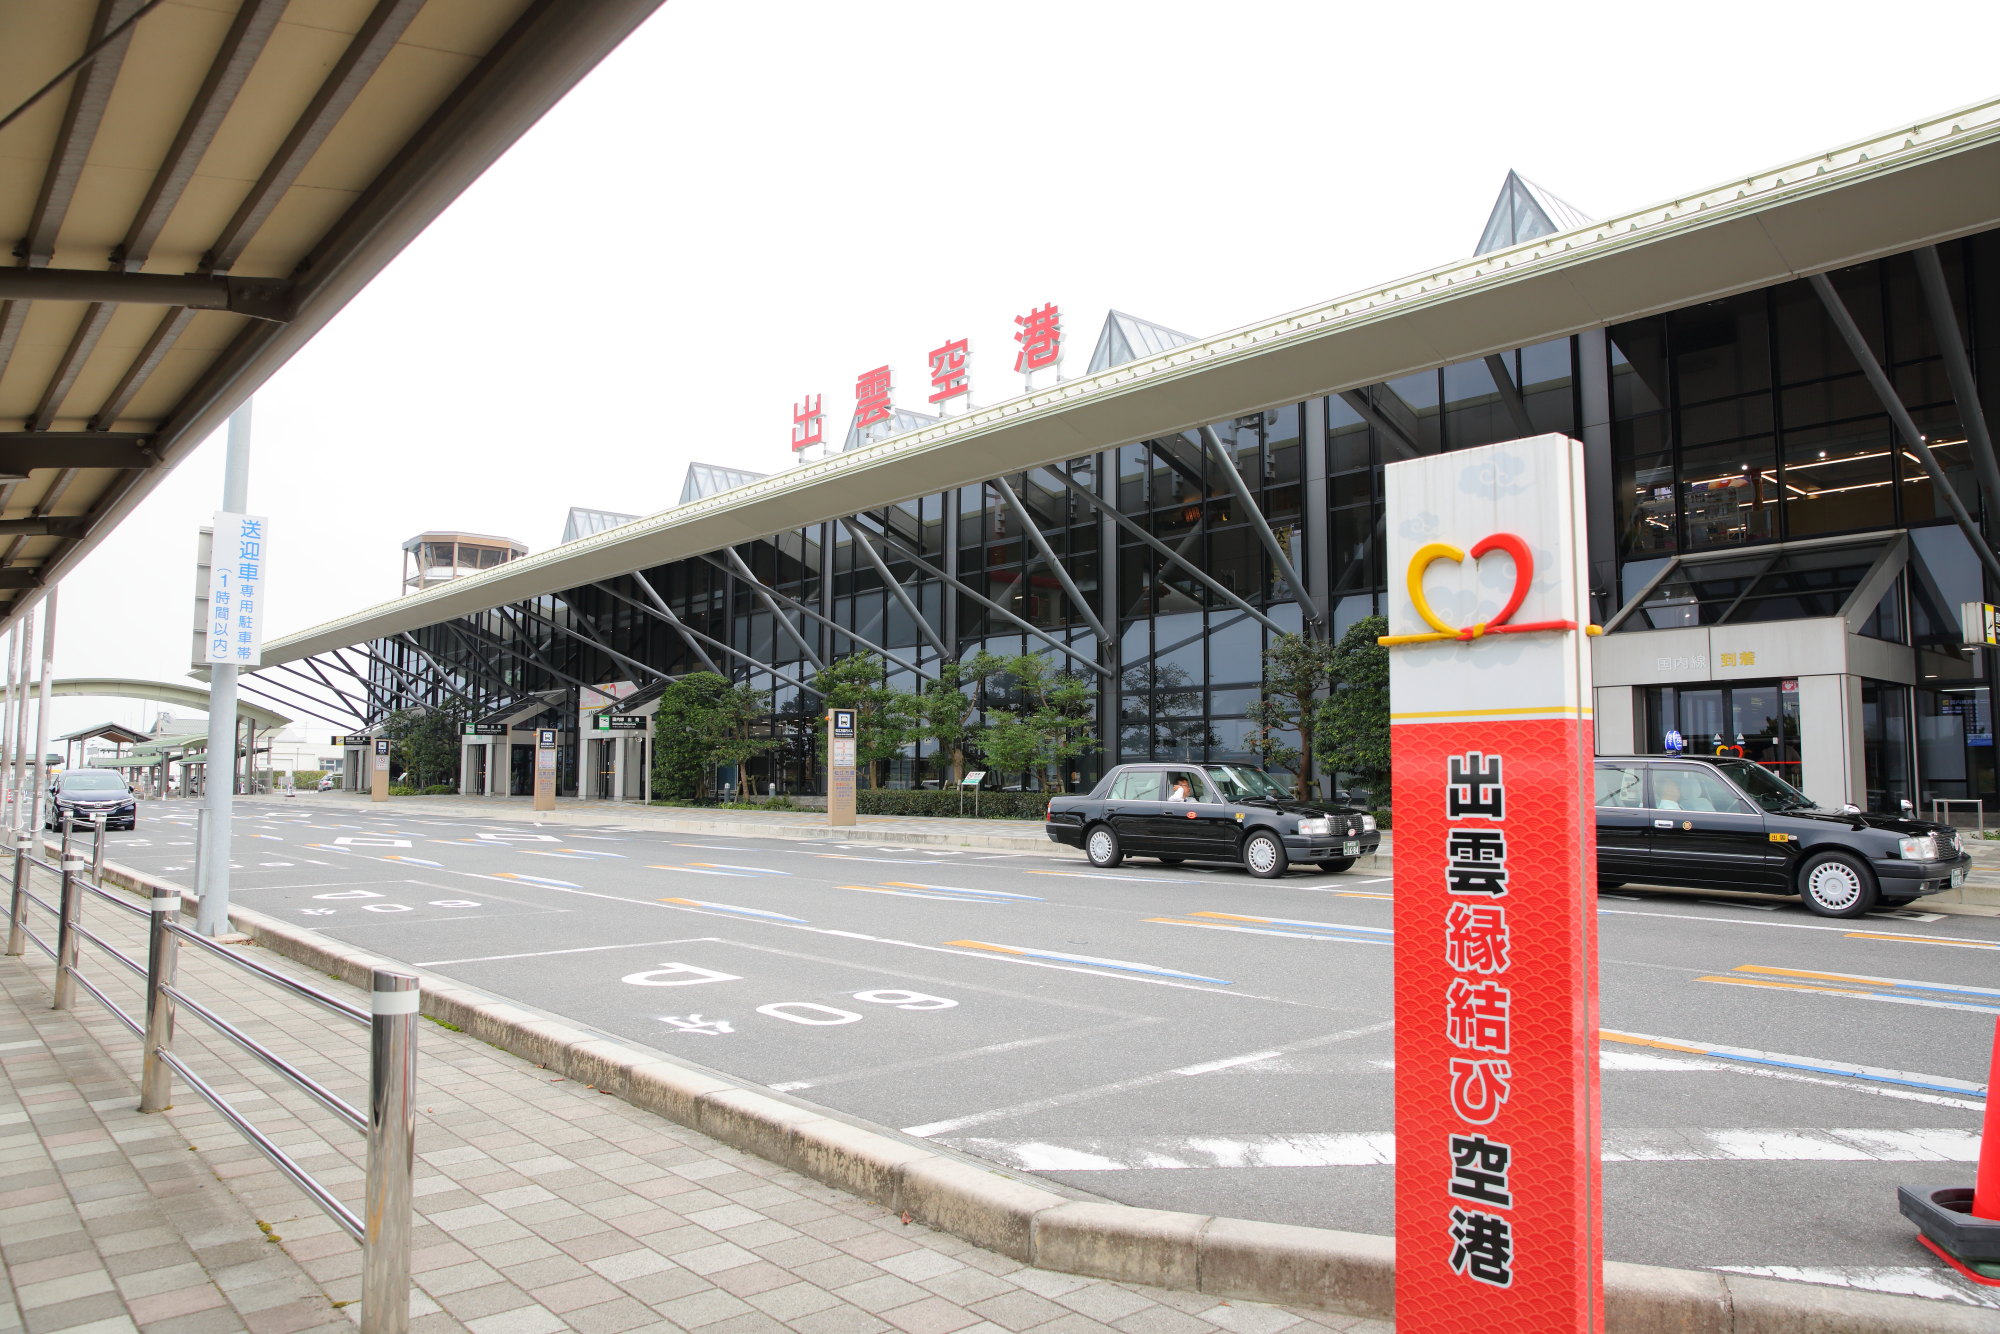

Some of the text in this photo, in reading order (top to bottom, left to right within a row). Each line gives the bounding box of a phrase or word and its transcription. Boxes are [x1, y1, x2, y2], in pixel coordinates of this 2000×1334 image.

[791, 302, 1066, 453] 出雲空港
[237, 519, 262, 660] 送迎車専用駐車帯
[1657, 651, 1755, 671] 国内線 到着
[621, 962, 744, 987] P
[1446, 751, 1513, 1289] 出雲縁結び空港
